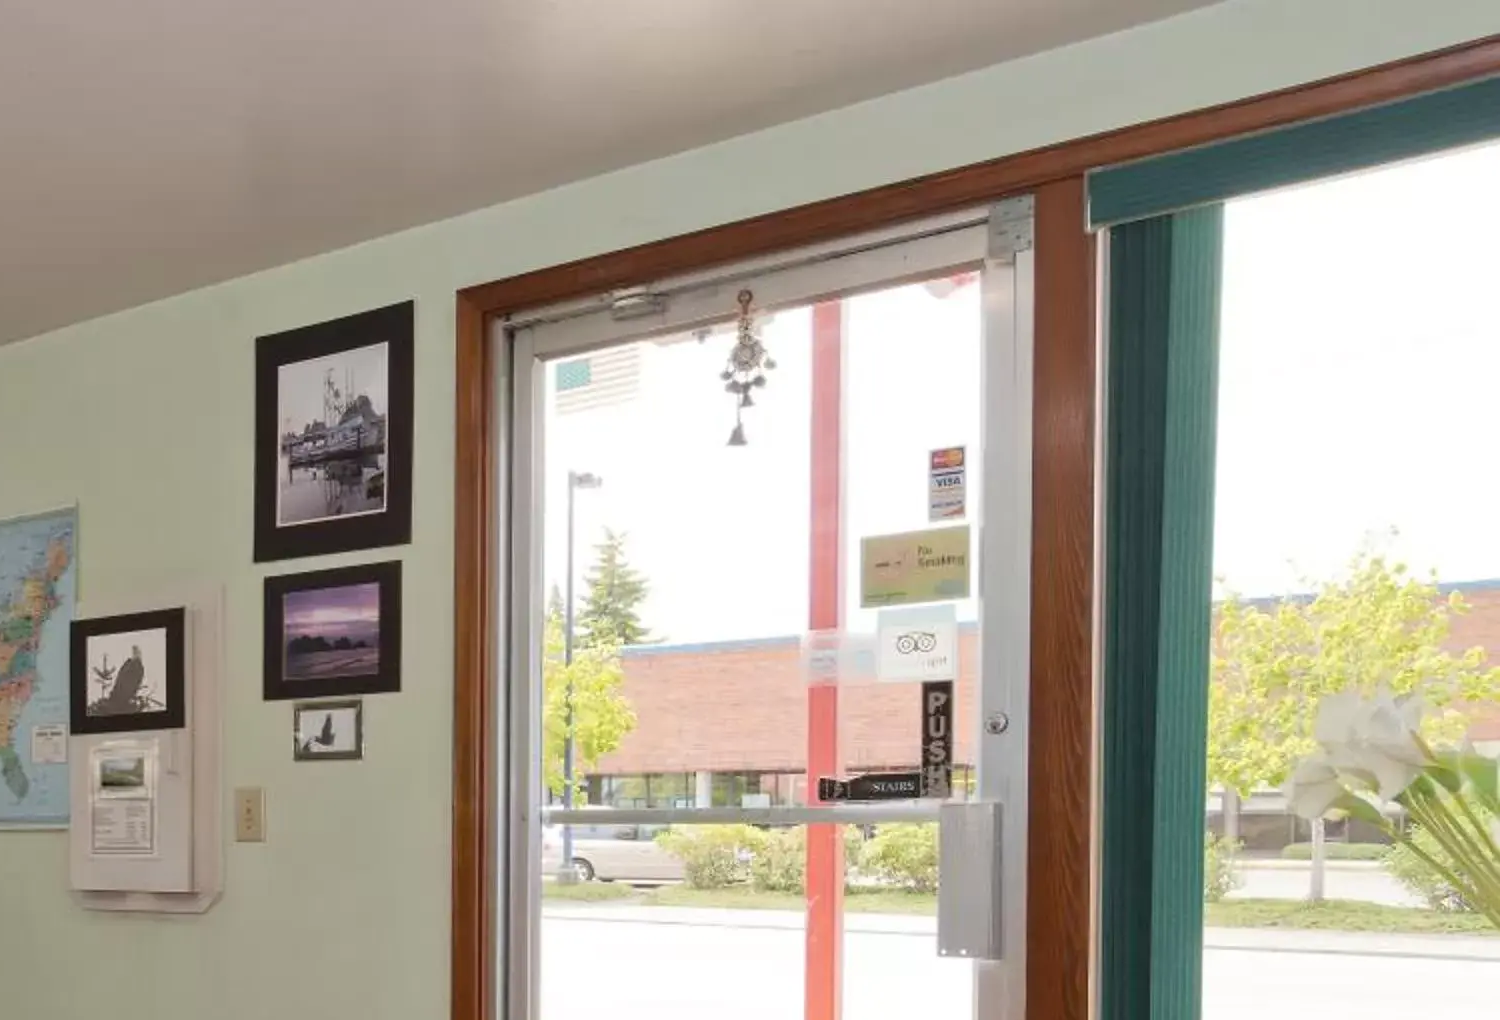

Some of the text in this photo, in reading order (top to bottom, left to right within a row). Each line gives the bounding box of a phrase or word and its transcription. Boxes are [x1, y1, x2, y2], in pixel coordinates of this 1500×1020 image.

[935, 476, 962, 488] VISA
[917, 553, 965, 568] Smoking
[928, 691, 949, 794] PUSH
[871, 780, 916, 793] STAIRS
